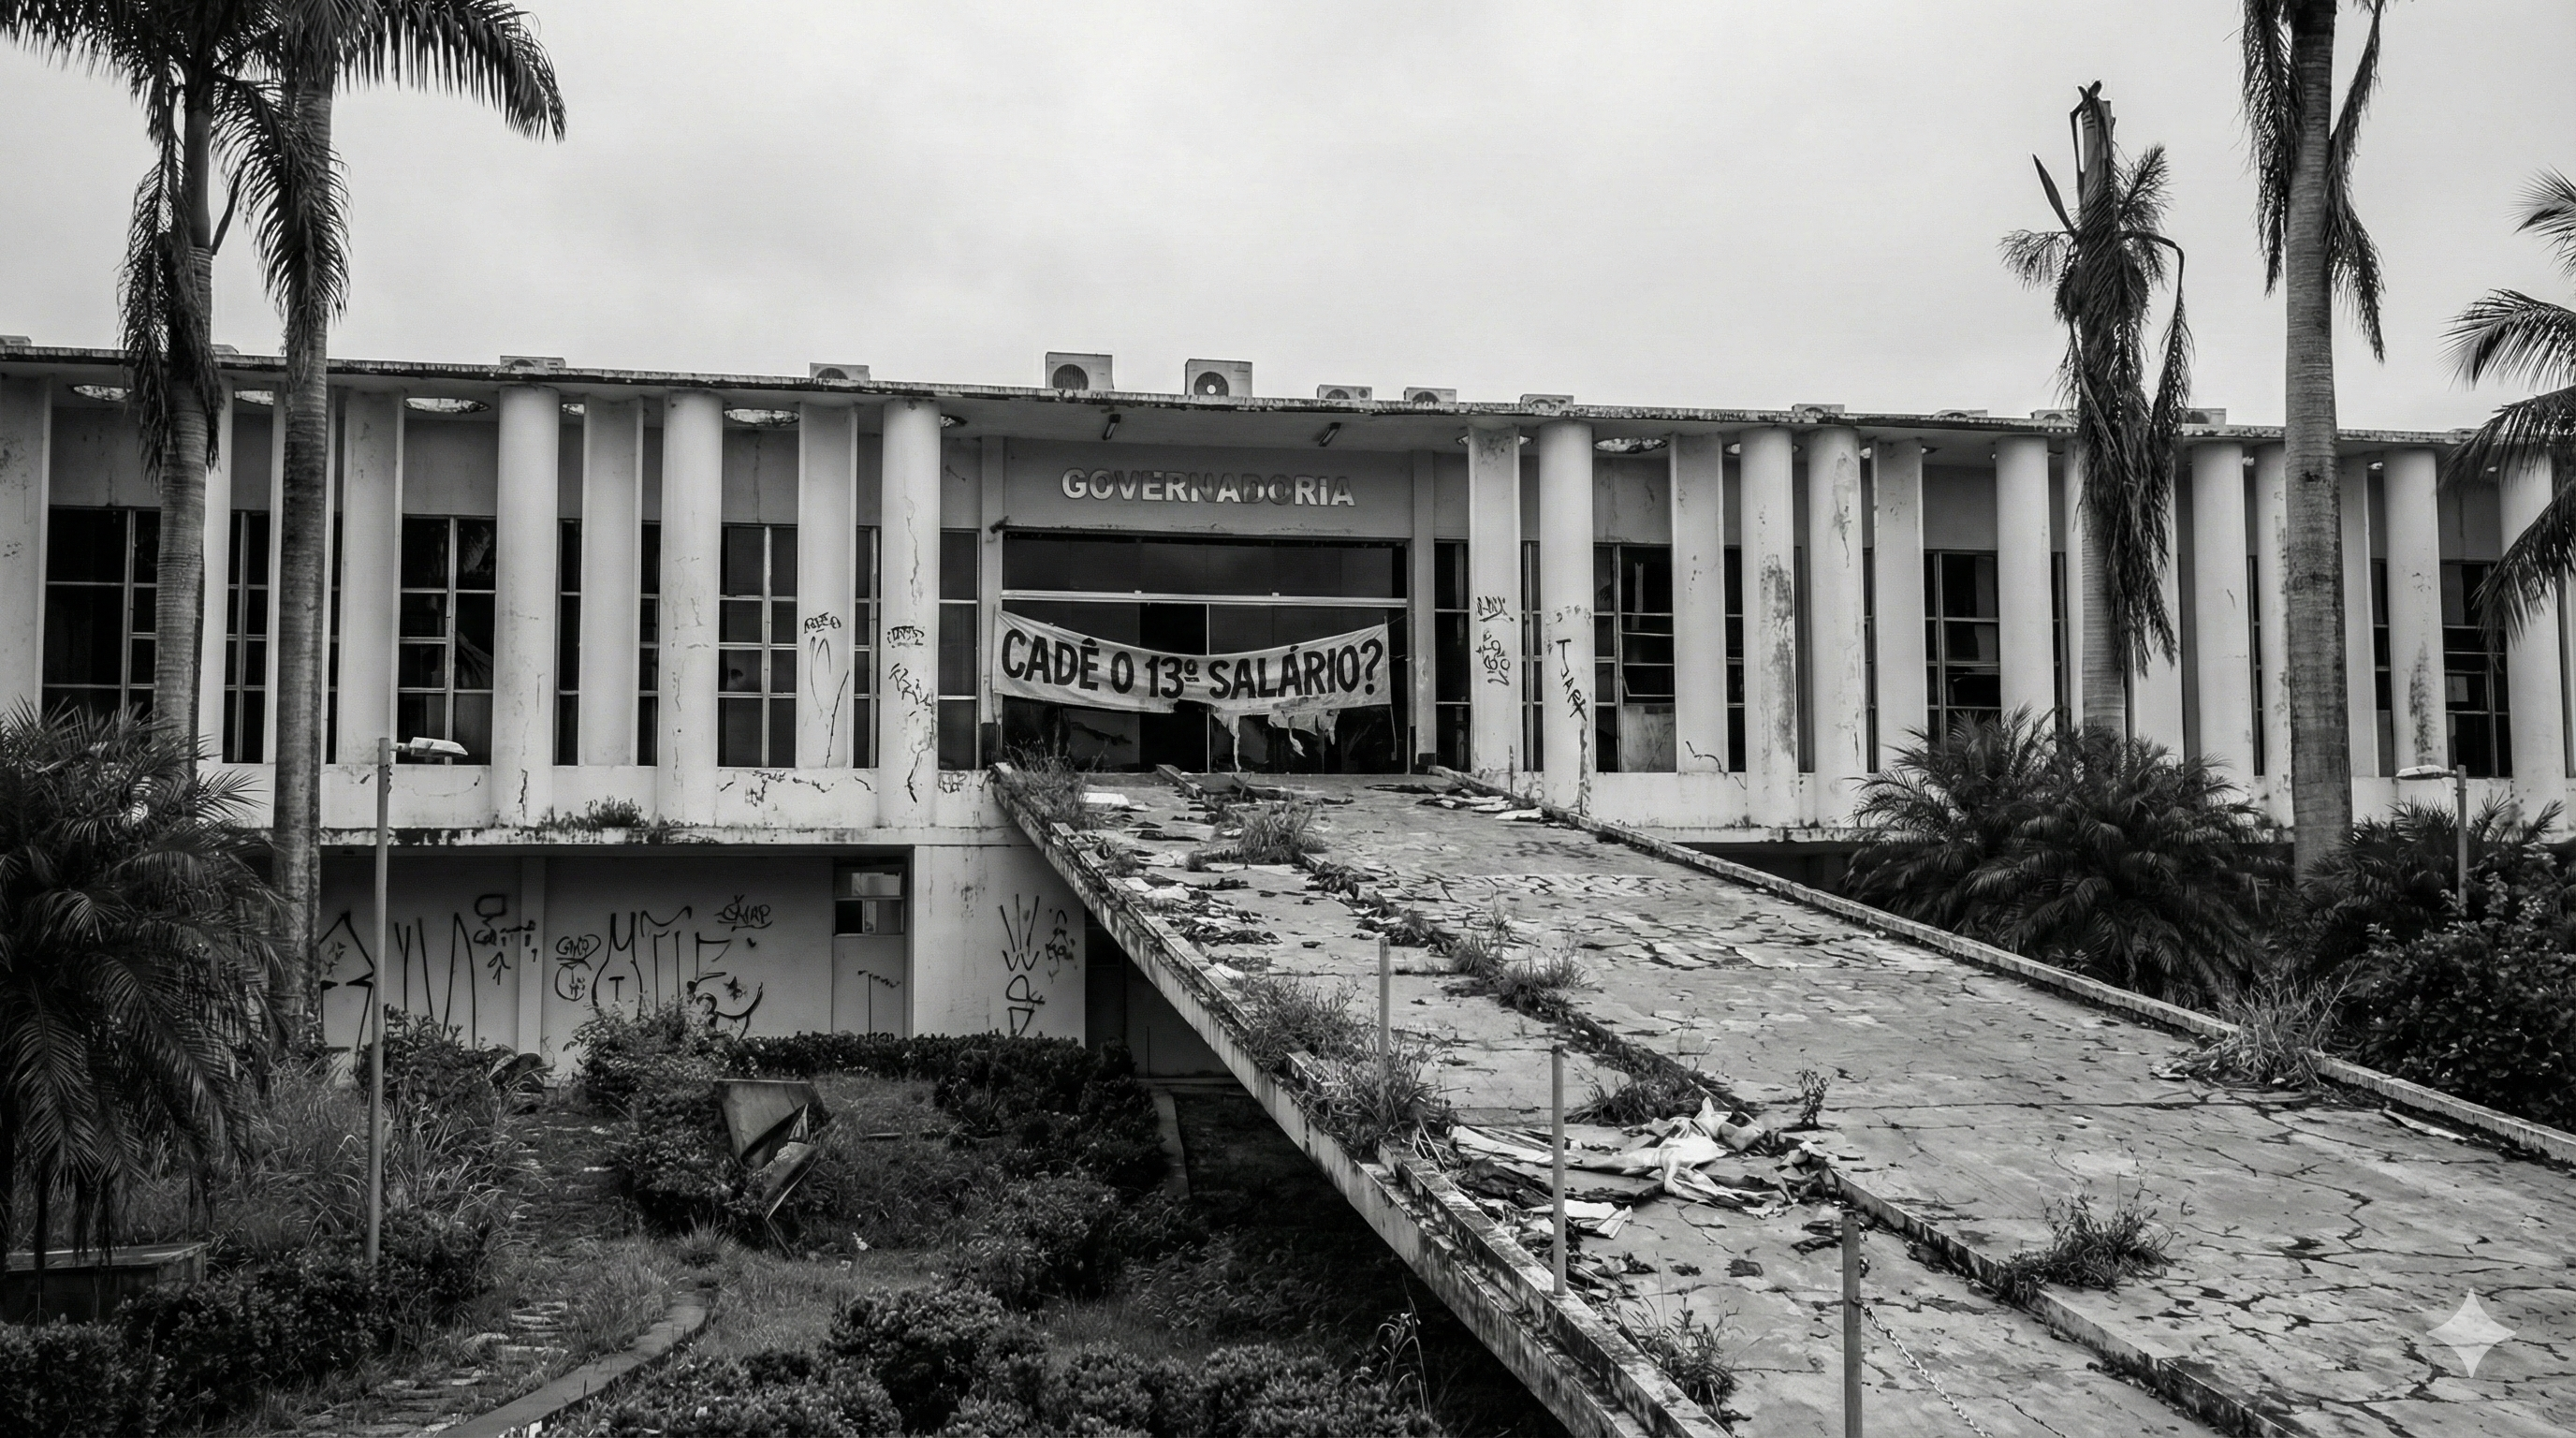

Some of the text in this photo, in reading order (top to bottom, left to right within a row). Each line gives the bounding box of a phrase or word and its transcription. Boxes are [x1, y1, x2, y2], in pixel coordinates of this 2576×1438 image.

[1061, 468, 1356, 506] GOVERNADORIA
[1002, 628, 1383, 700] CADÊ O 13º SALÁRIO?
